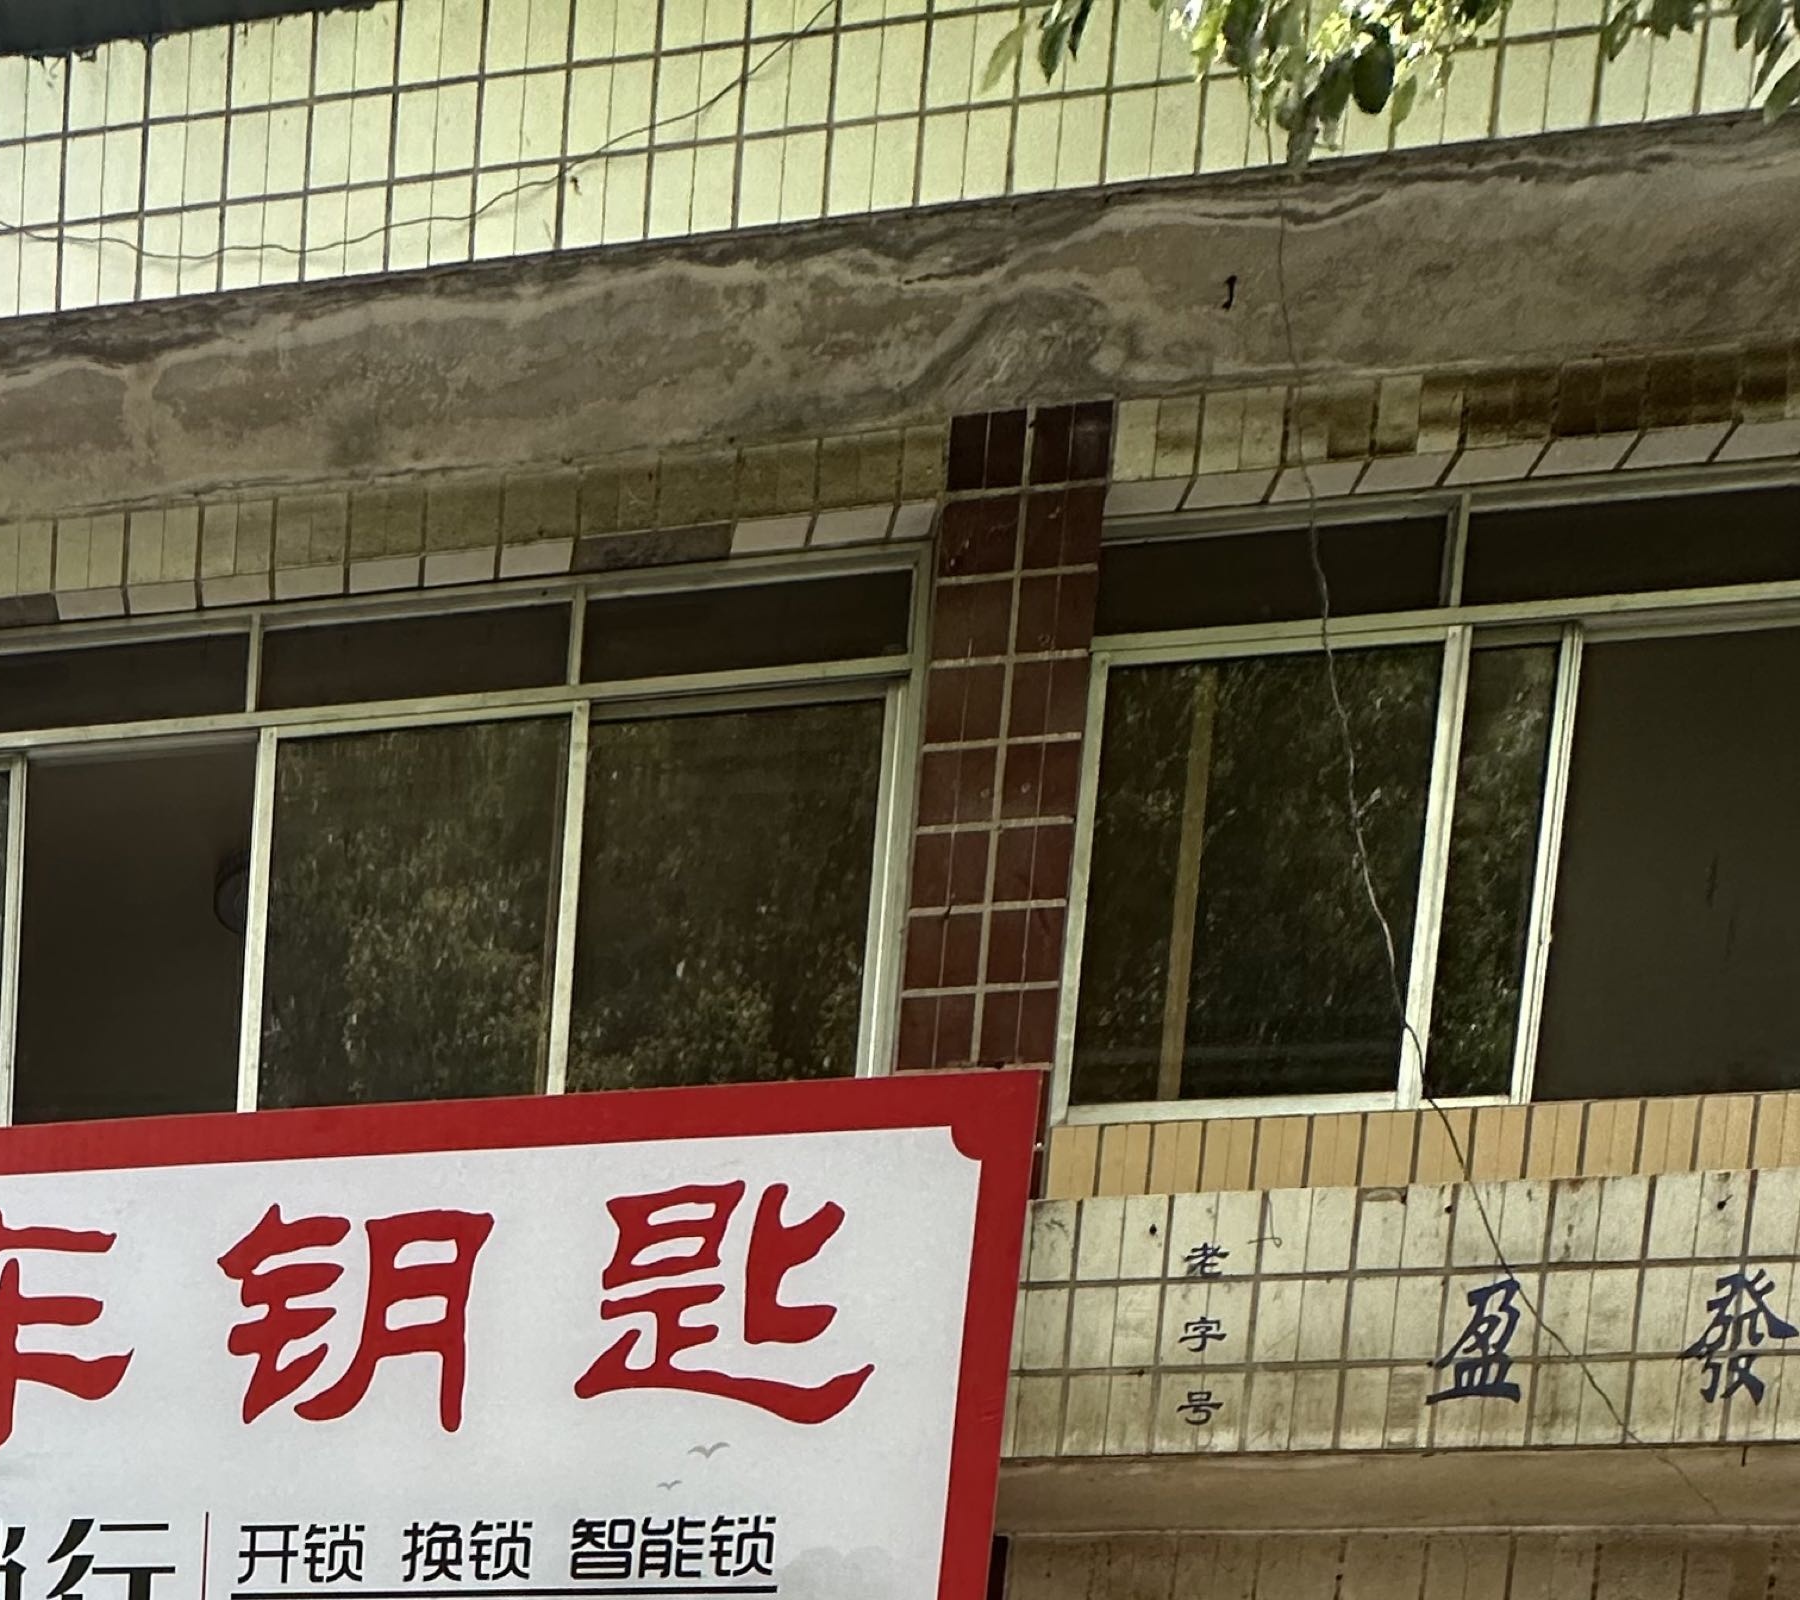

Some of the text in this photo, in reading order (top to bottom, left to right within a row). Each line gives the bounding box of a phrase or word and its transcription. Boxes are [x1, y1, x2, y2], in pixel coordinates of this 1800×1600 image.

[1175, 1240, 1230, 1426] 老字号
[237, 1515, 777, 1585] 开锁 换锁 智能锁
